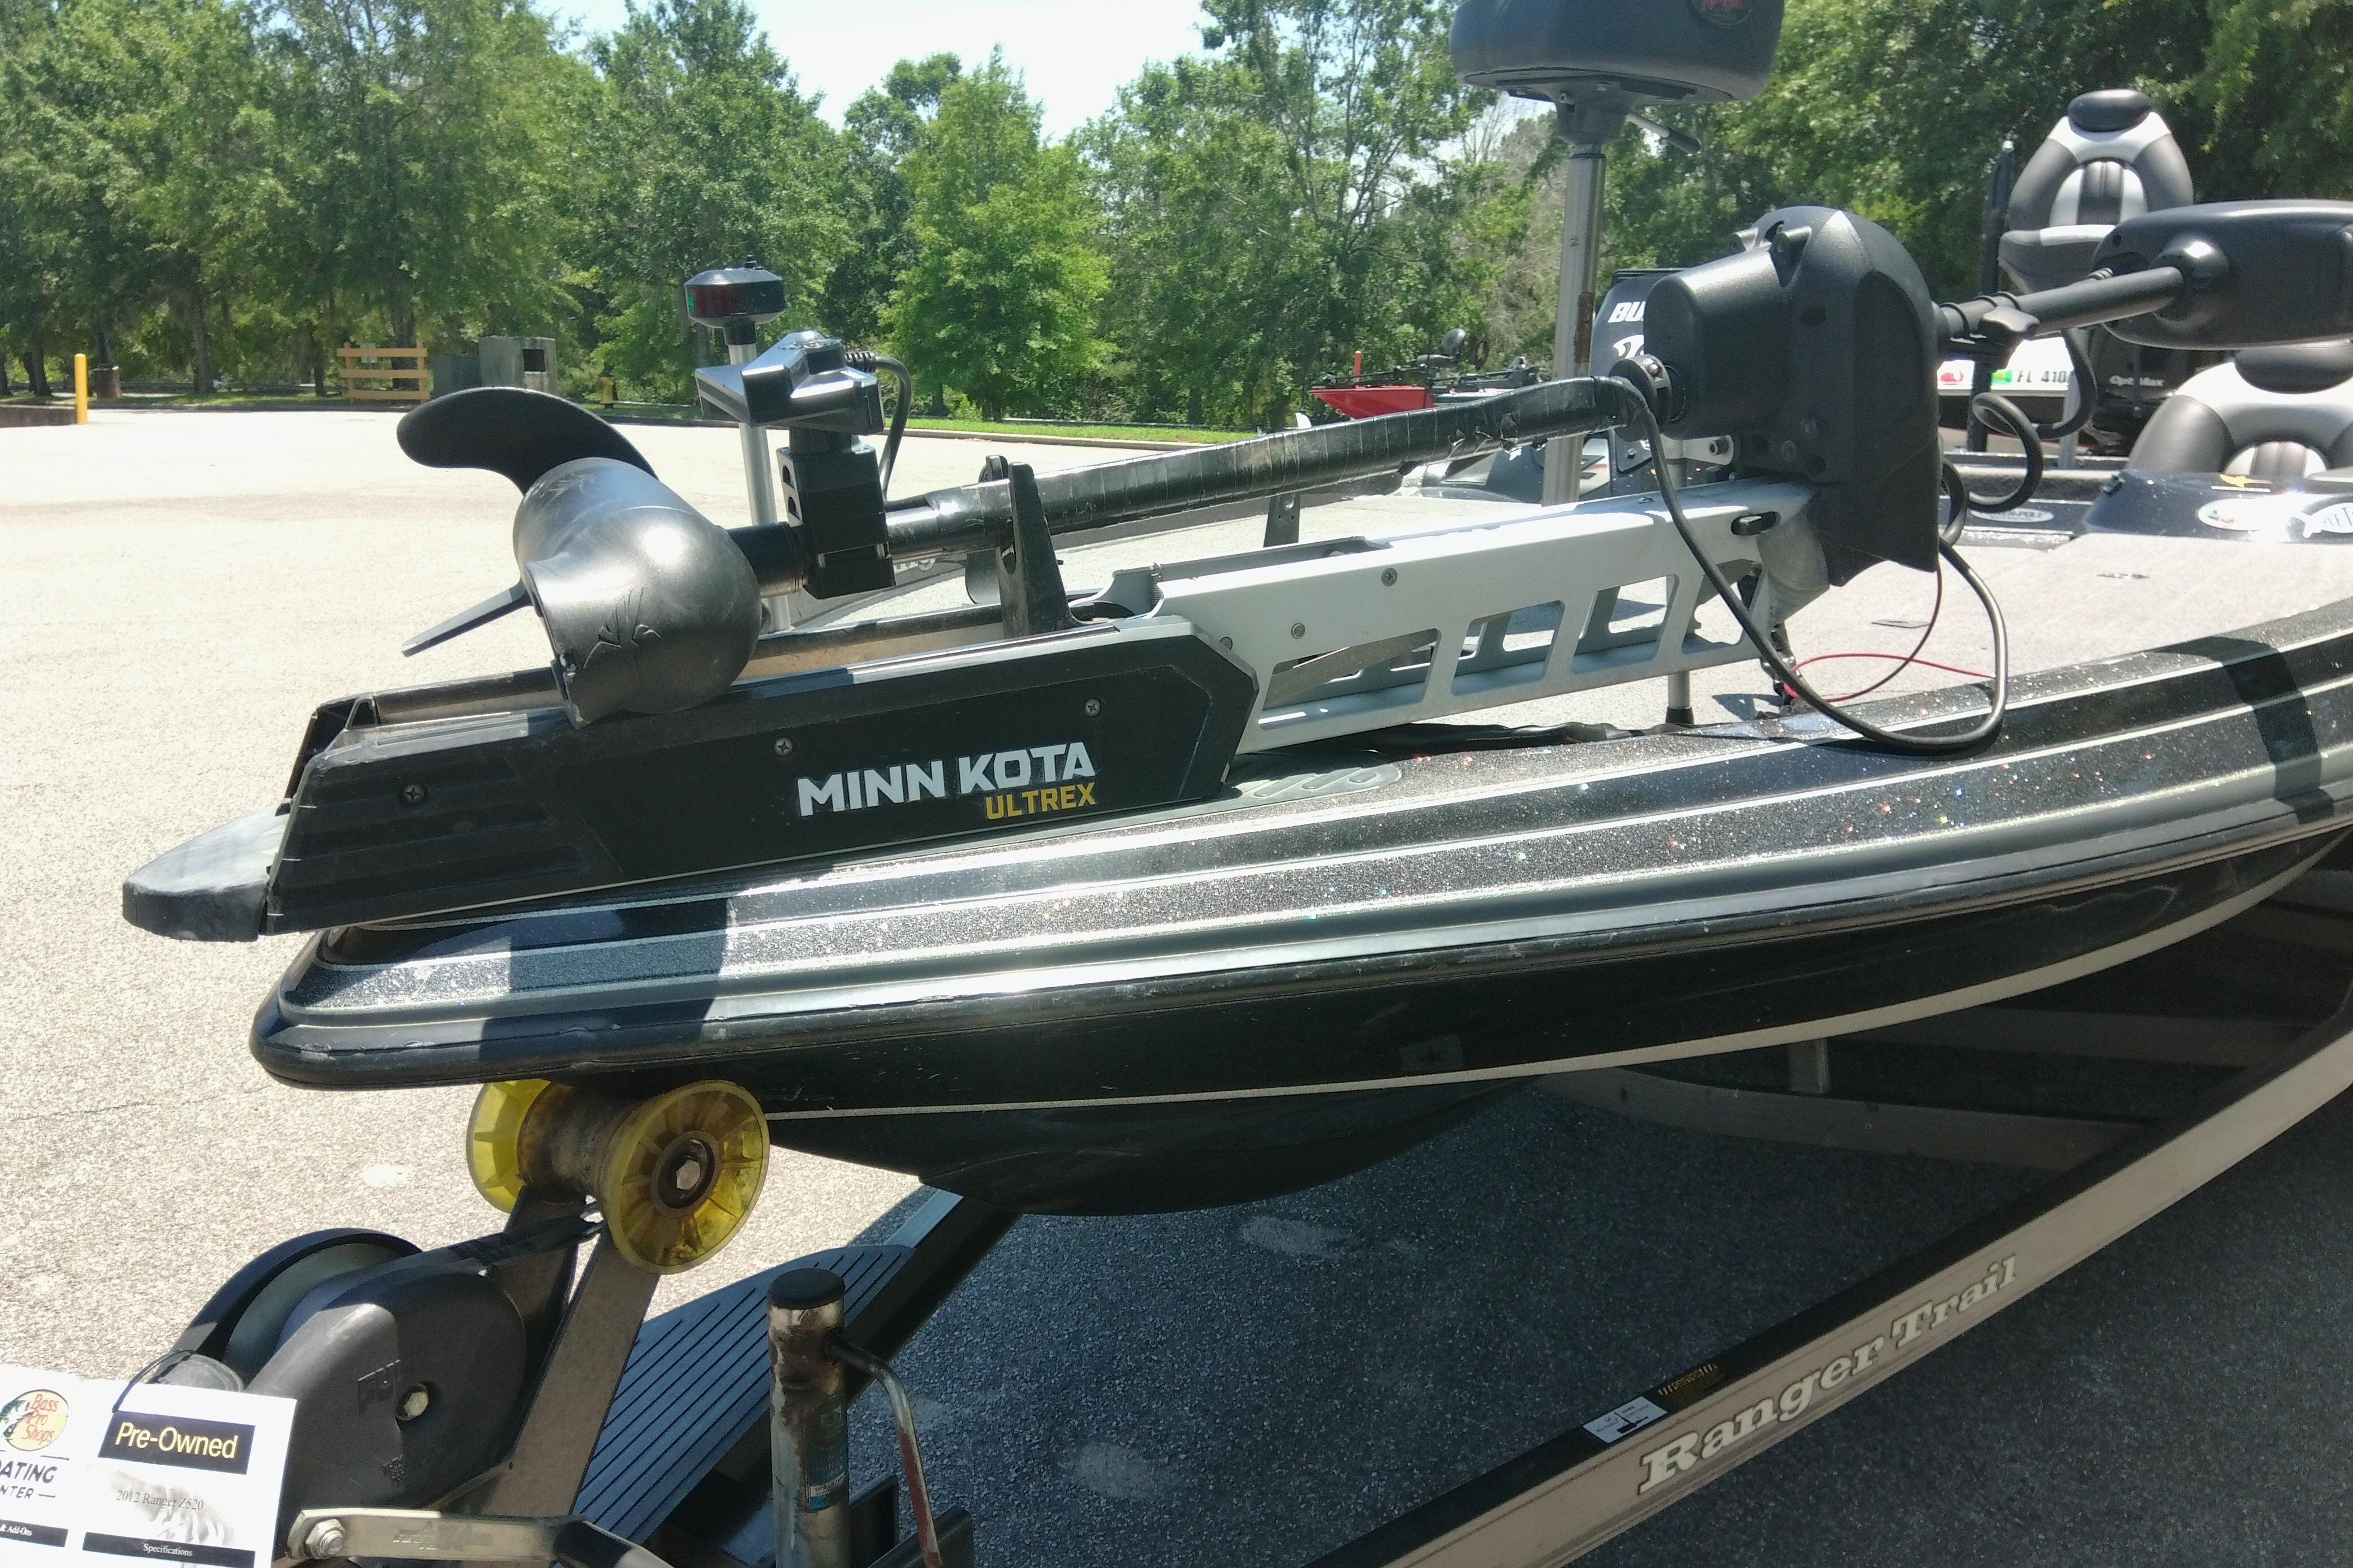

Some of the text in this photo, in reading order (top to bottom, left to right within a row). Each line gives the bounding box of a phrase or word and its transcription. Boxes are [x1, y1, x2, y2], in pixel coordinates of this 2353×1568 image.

[1608, 301, 1647, 323] BU
[2016, 370, 2032, 383] FL
[797, 741, 1096, 817] MINN KOTA
[985, 782, 1097, 820] ULTREX
[1637, 1255, 2018, 1495] Ranger Trail
[30, 1393, 59, 1412] Bass
[26, 1410, 49, 1425] Pro
[21, 1424, 55, 1445] Shops
[115, 1422, 238, 1459] Pre-Owned
[0, 1459, 58, 1484] ATING
[116, 1490, 204, 1510] 2012 Ranger Z520
[6, 1525, 33, 1536] Add-Ons
[143, 1543, 193, 1557] Specifications
